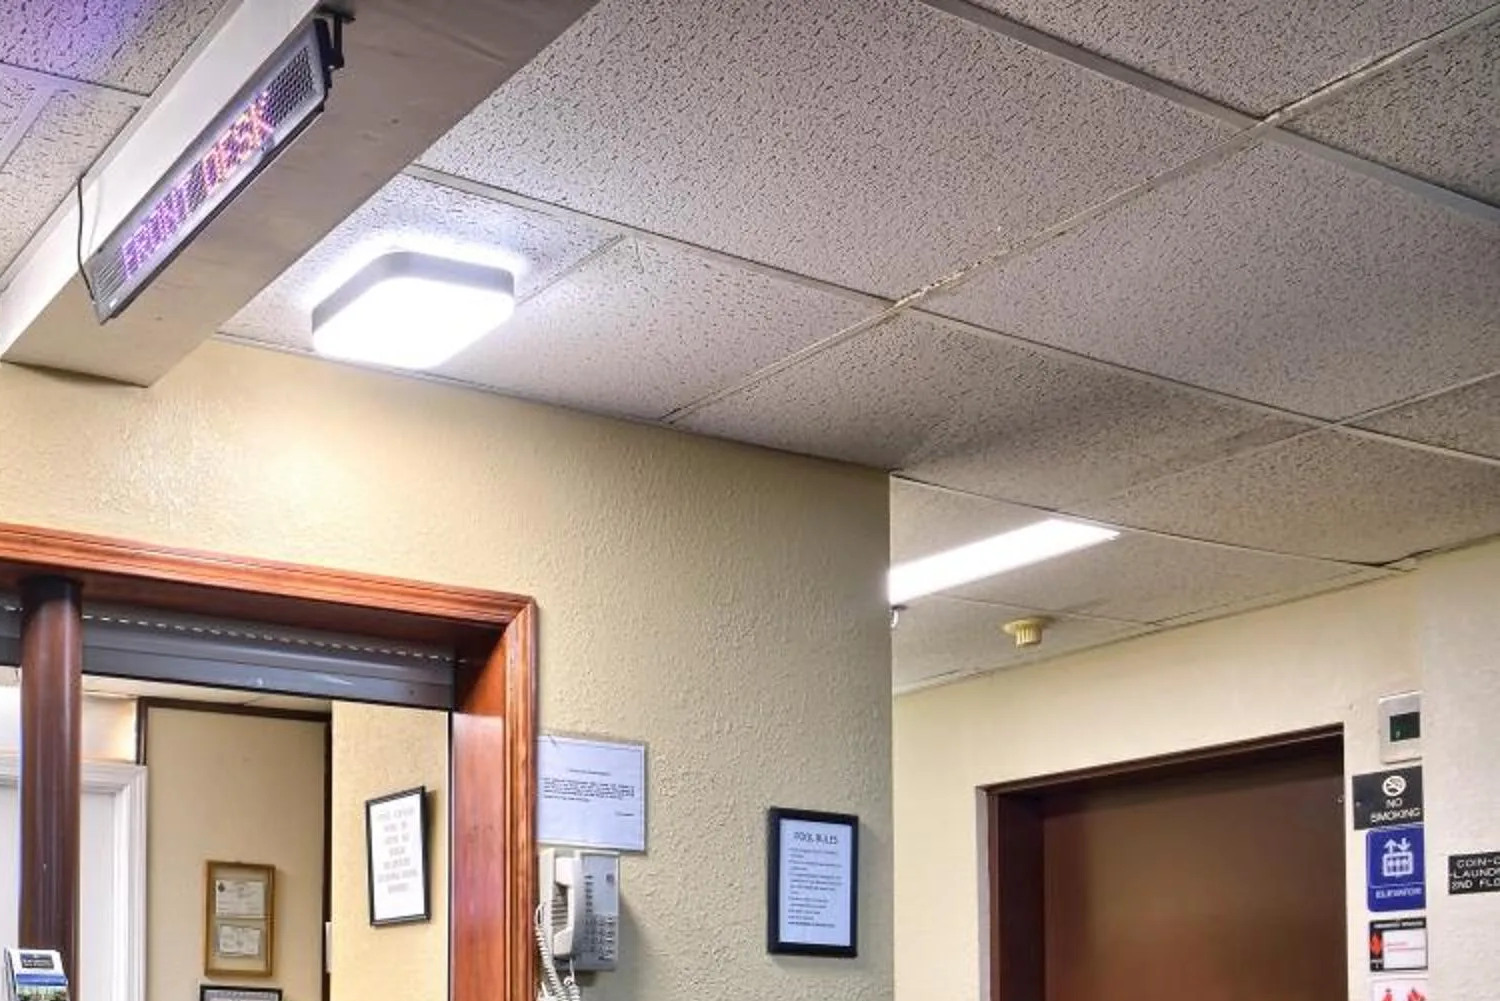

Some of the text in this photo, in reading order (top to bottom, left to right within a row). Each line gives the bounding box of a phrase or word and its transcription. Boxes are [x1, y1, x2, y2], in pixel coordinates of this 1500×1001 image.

[121, 91, 275, 280] FRONT DESK
[1386, 798, 1403, 808] NO
[1370, 807, 1421, 823] SMOKING
[1375, 887, 1422, 899] ELEVATOR
